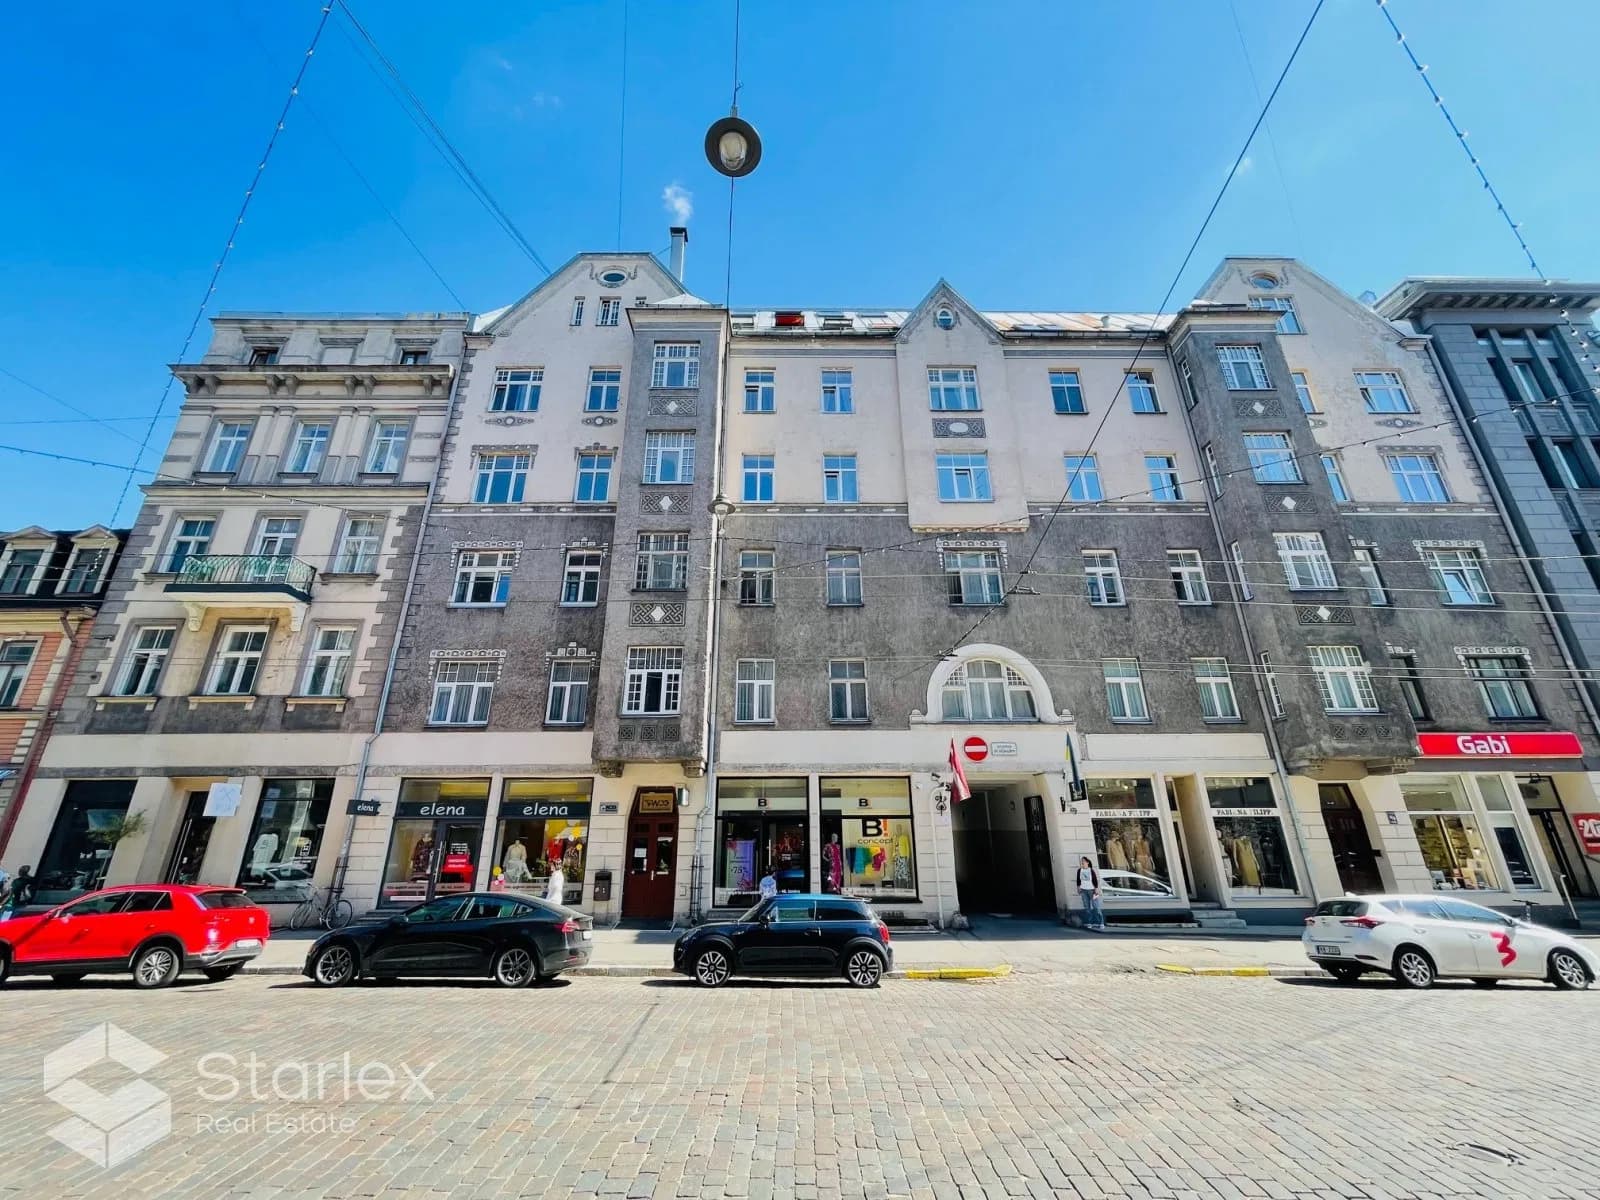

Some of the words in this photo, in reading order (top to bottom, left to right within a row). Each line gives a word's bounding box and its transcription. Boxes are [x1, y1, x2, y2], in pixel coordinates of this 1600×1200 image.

[1456, 736, 1511, 754] Gabi
[420, 802, 465, 816] elena
[523, 802, 568, 816] elena
[862, 817, 889, 838] B!
